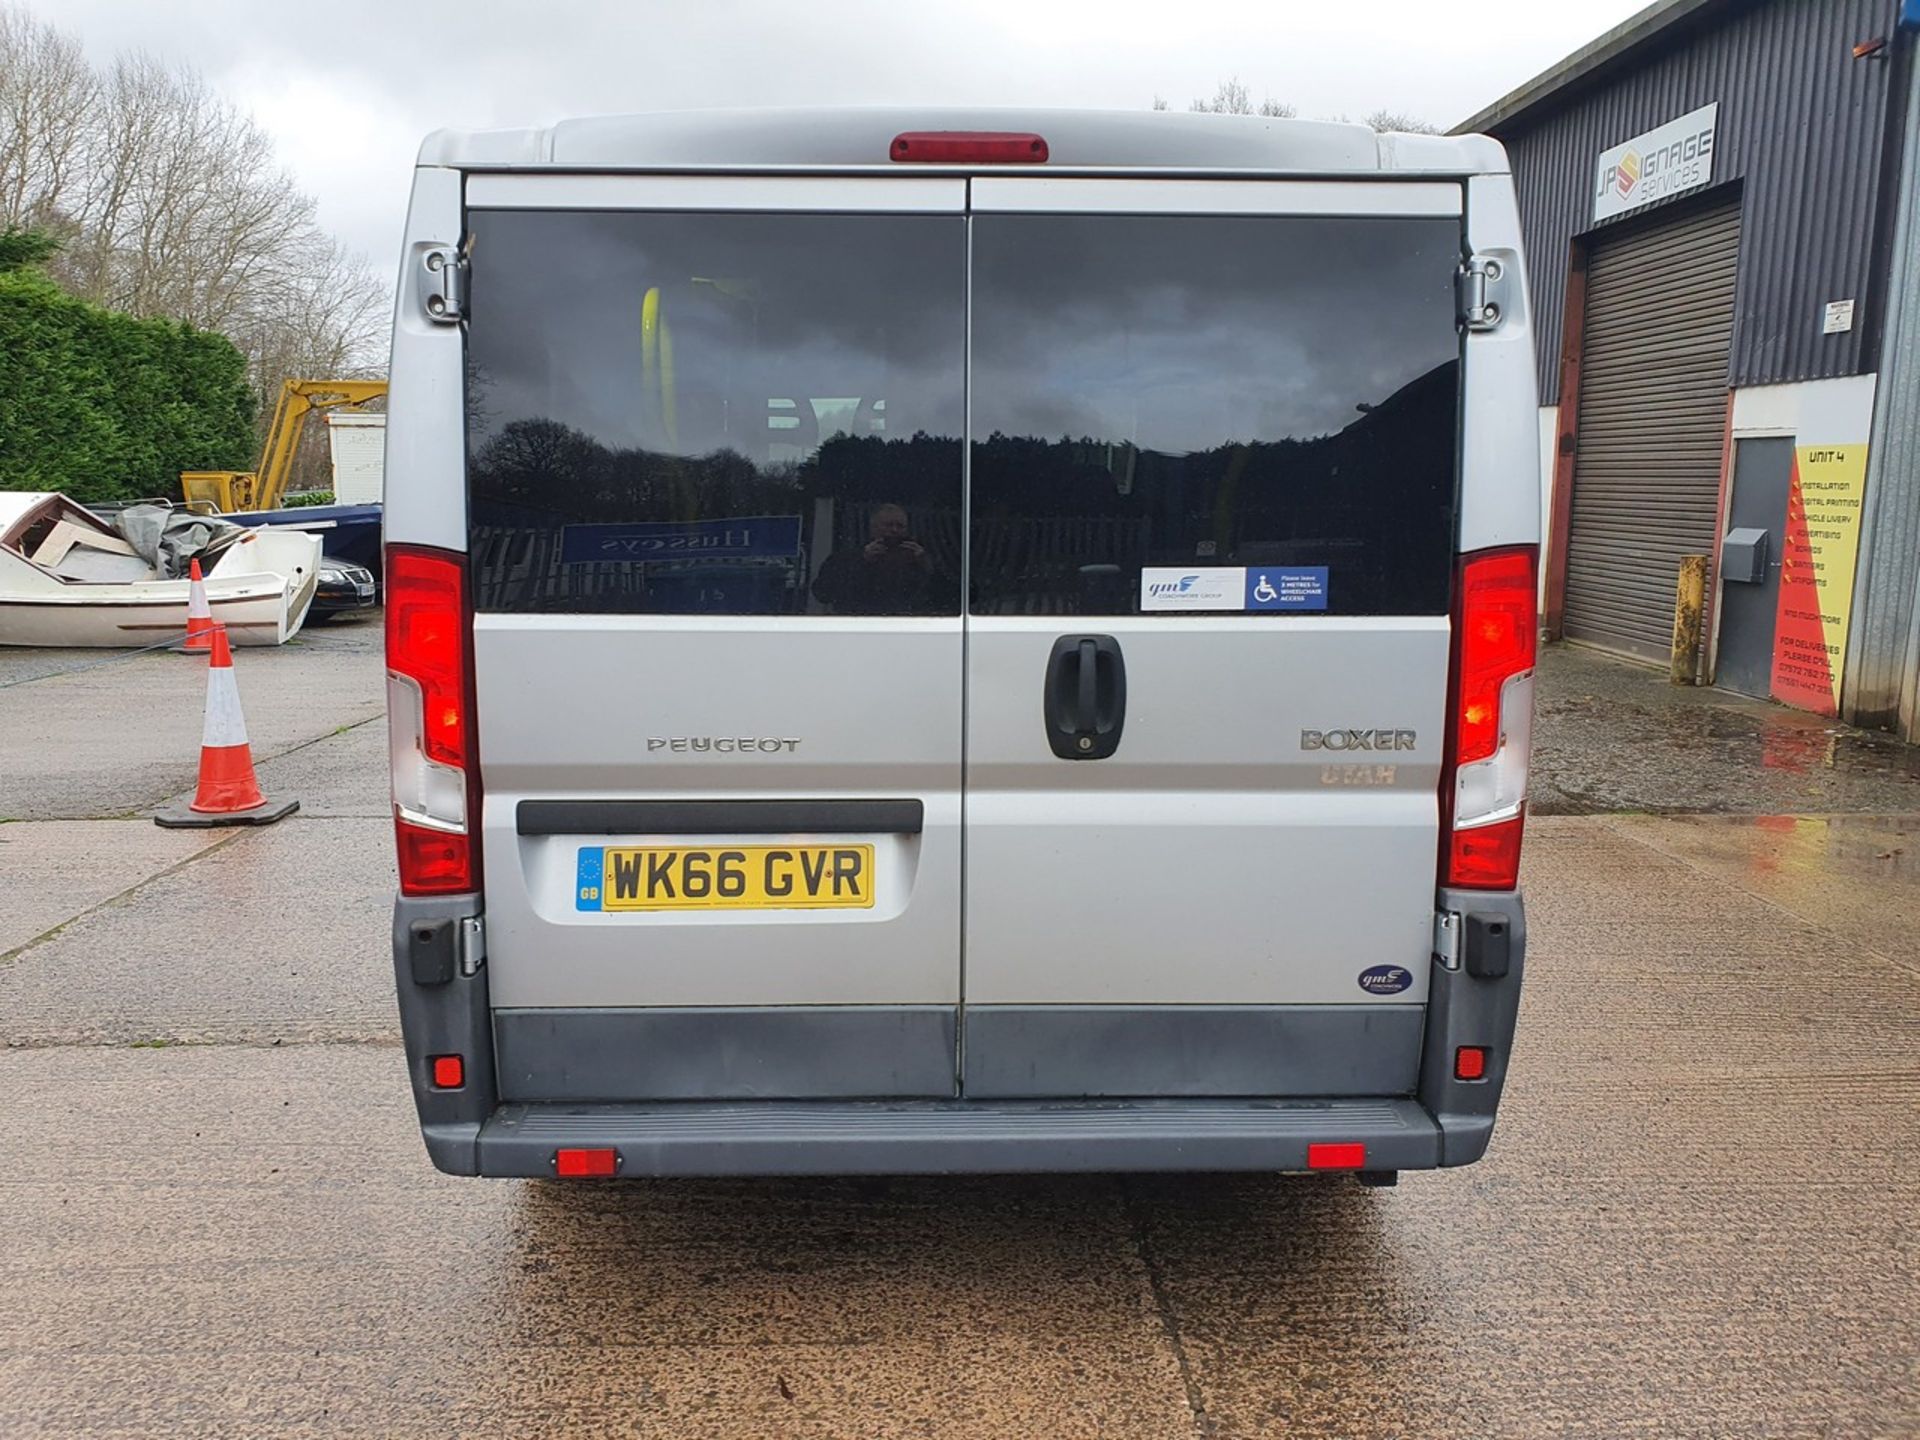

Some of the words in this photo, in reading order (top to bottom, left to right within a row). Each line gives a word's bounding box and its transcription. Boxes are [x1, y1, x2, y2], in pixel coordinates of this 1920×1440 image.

[1640, 162, 1700, 201] services
[1809, 451, 1835, 463] UNIT
[1836, 451, 1845, 462] 4
[1800, 481, 1850, 491] INSTALLATION
[1799, 497, 1825, 506] DIGITAL
[1826, 498, 1860, 508] PRINTING
[1798, 513, 1826, 523] VEHICLE
[1826, 515, 1852, 524] LIVERY
[1780, 636, 1794, 646] FOR
[1795, 638, 1840, 655] DELIVERIES
[1783, 650, 1812, 664] PLEASE
[647, 736, 802, 753] PEUGEOT
[1301, 729, 1417, 751] BOXER
[613, 851, 746, 899] WK66
[763, 850, 862, 897] GVR
[580, 887, 599, 900] GB
